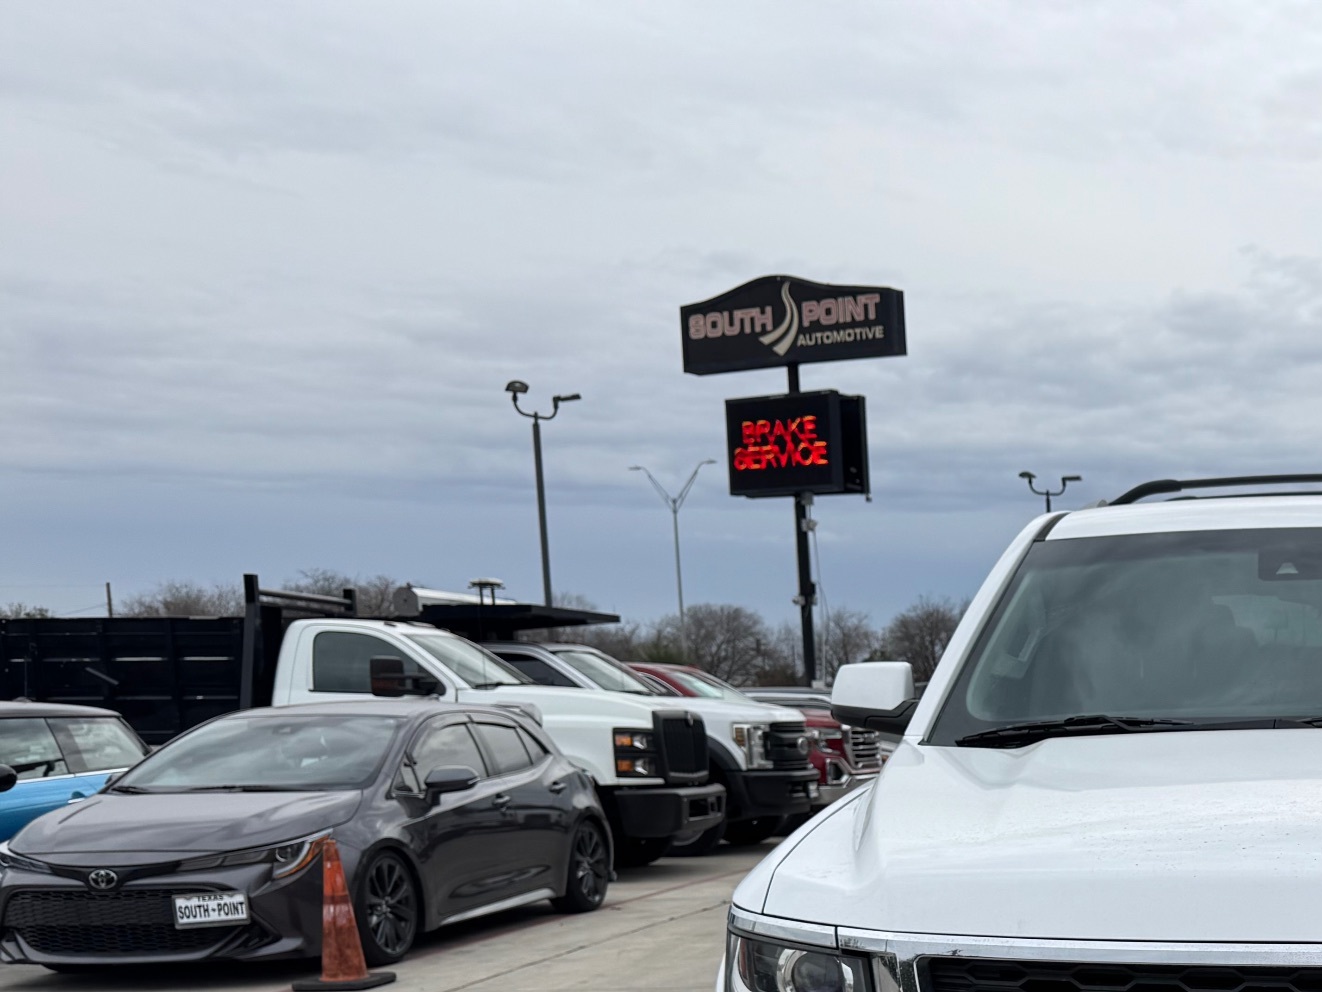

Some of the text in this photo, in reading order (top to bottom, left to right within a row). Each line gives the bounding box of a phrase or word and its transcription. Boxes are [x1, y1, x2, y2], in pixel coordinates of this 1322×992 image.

[688, 292, 881, 340] SOUTH POINT
[797, 325, 885, 348] AUTOMOTIVE
[741, 415, 818, 444] BRAKE
[733, 440, 829, 470] SERVICE
[178, 902, 245, 920] SOUTH POINT
